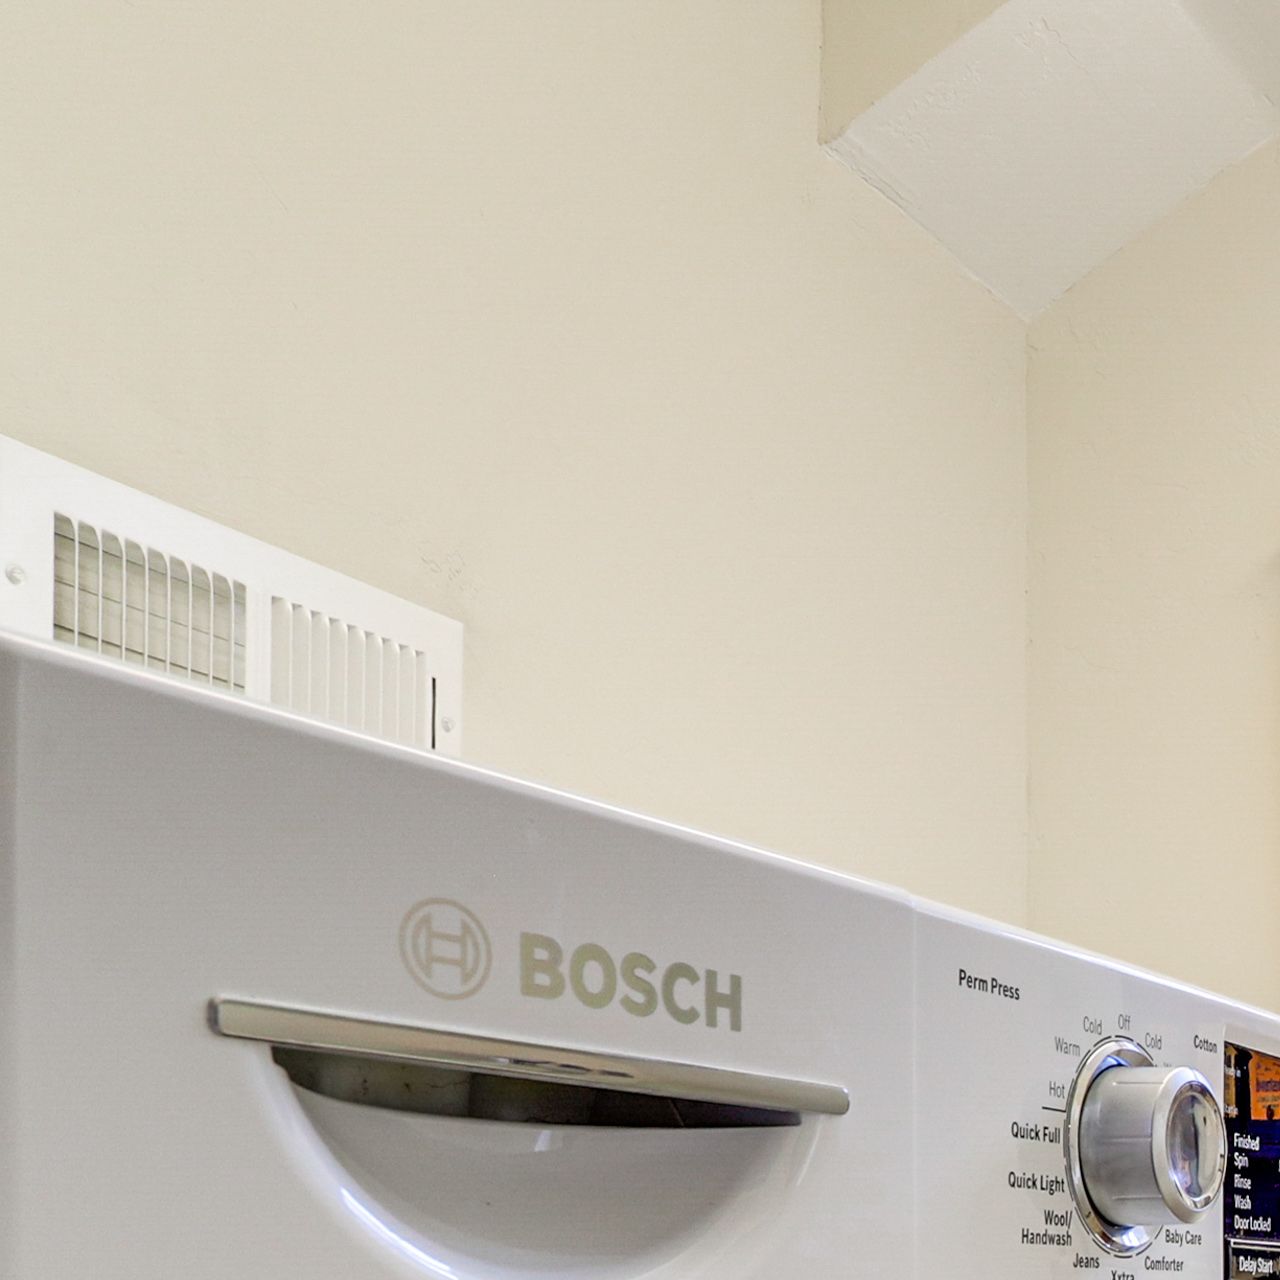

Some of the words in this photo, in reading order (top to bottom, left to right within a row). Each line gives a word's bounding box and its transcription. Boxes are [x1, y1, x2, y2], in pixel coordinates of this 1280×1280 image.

[519, 931, 742, 1033] BOSCH
[958, 968, 989, 993] Perm
[990, 977, 1020, 1001] Press
[1083, 1015, 1103, 1036] Cold
[1117, 1014, 1131, 1031] Off
[1054, 1036, 1081, 1057] Warm
[1144, 1032, 1162, 1050] Cold
[1193, 1034, 1218, 1053] Cotton
[1049, 1080, 1065, 1099] Hot
[1011, 1121, 1041, 1141] Quick
[1042, 1126, 1061, 1144] Full
[1234, 1132, 1260, 1151] Finished
[1234, 1152, 1249, 1169] Spin
[1008, 1171, 1038, 1191] Quick
[1040, 1175, 1065, 1195] Light
[1234, 1173, 1251, 1190] Rinse
[1234, 1194, 1251, 1210] Wash
[1044, 1209, 1073, 1229] Wool/
[1234, 1214, 1249, 1231] Door
[1250, 1216, 1271, 1232] Locked
[1021, 1228, 1072, 1246] Handwash
[1165, 1229, 1184, 1247] Baby
[1184, 1231, 1202, 1245] Care
[1073, 1253, 1100, 1269] Jeans
[1144, 1256, 1184, 1272] Comforter
[1239, 1255, 1257, 1275] Delay
[1257, 1257, 1273, 1273] Start
